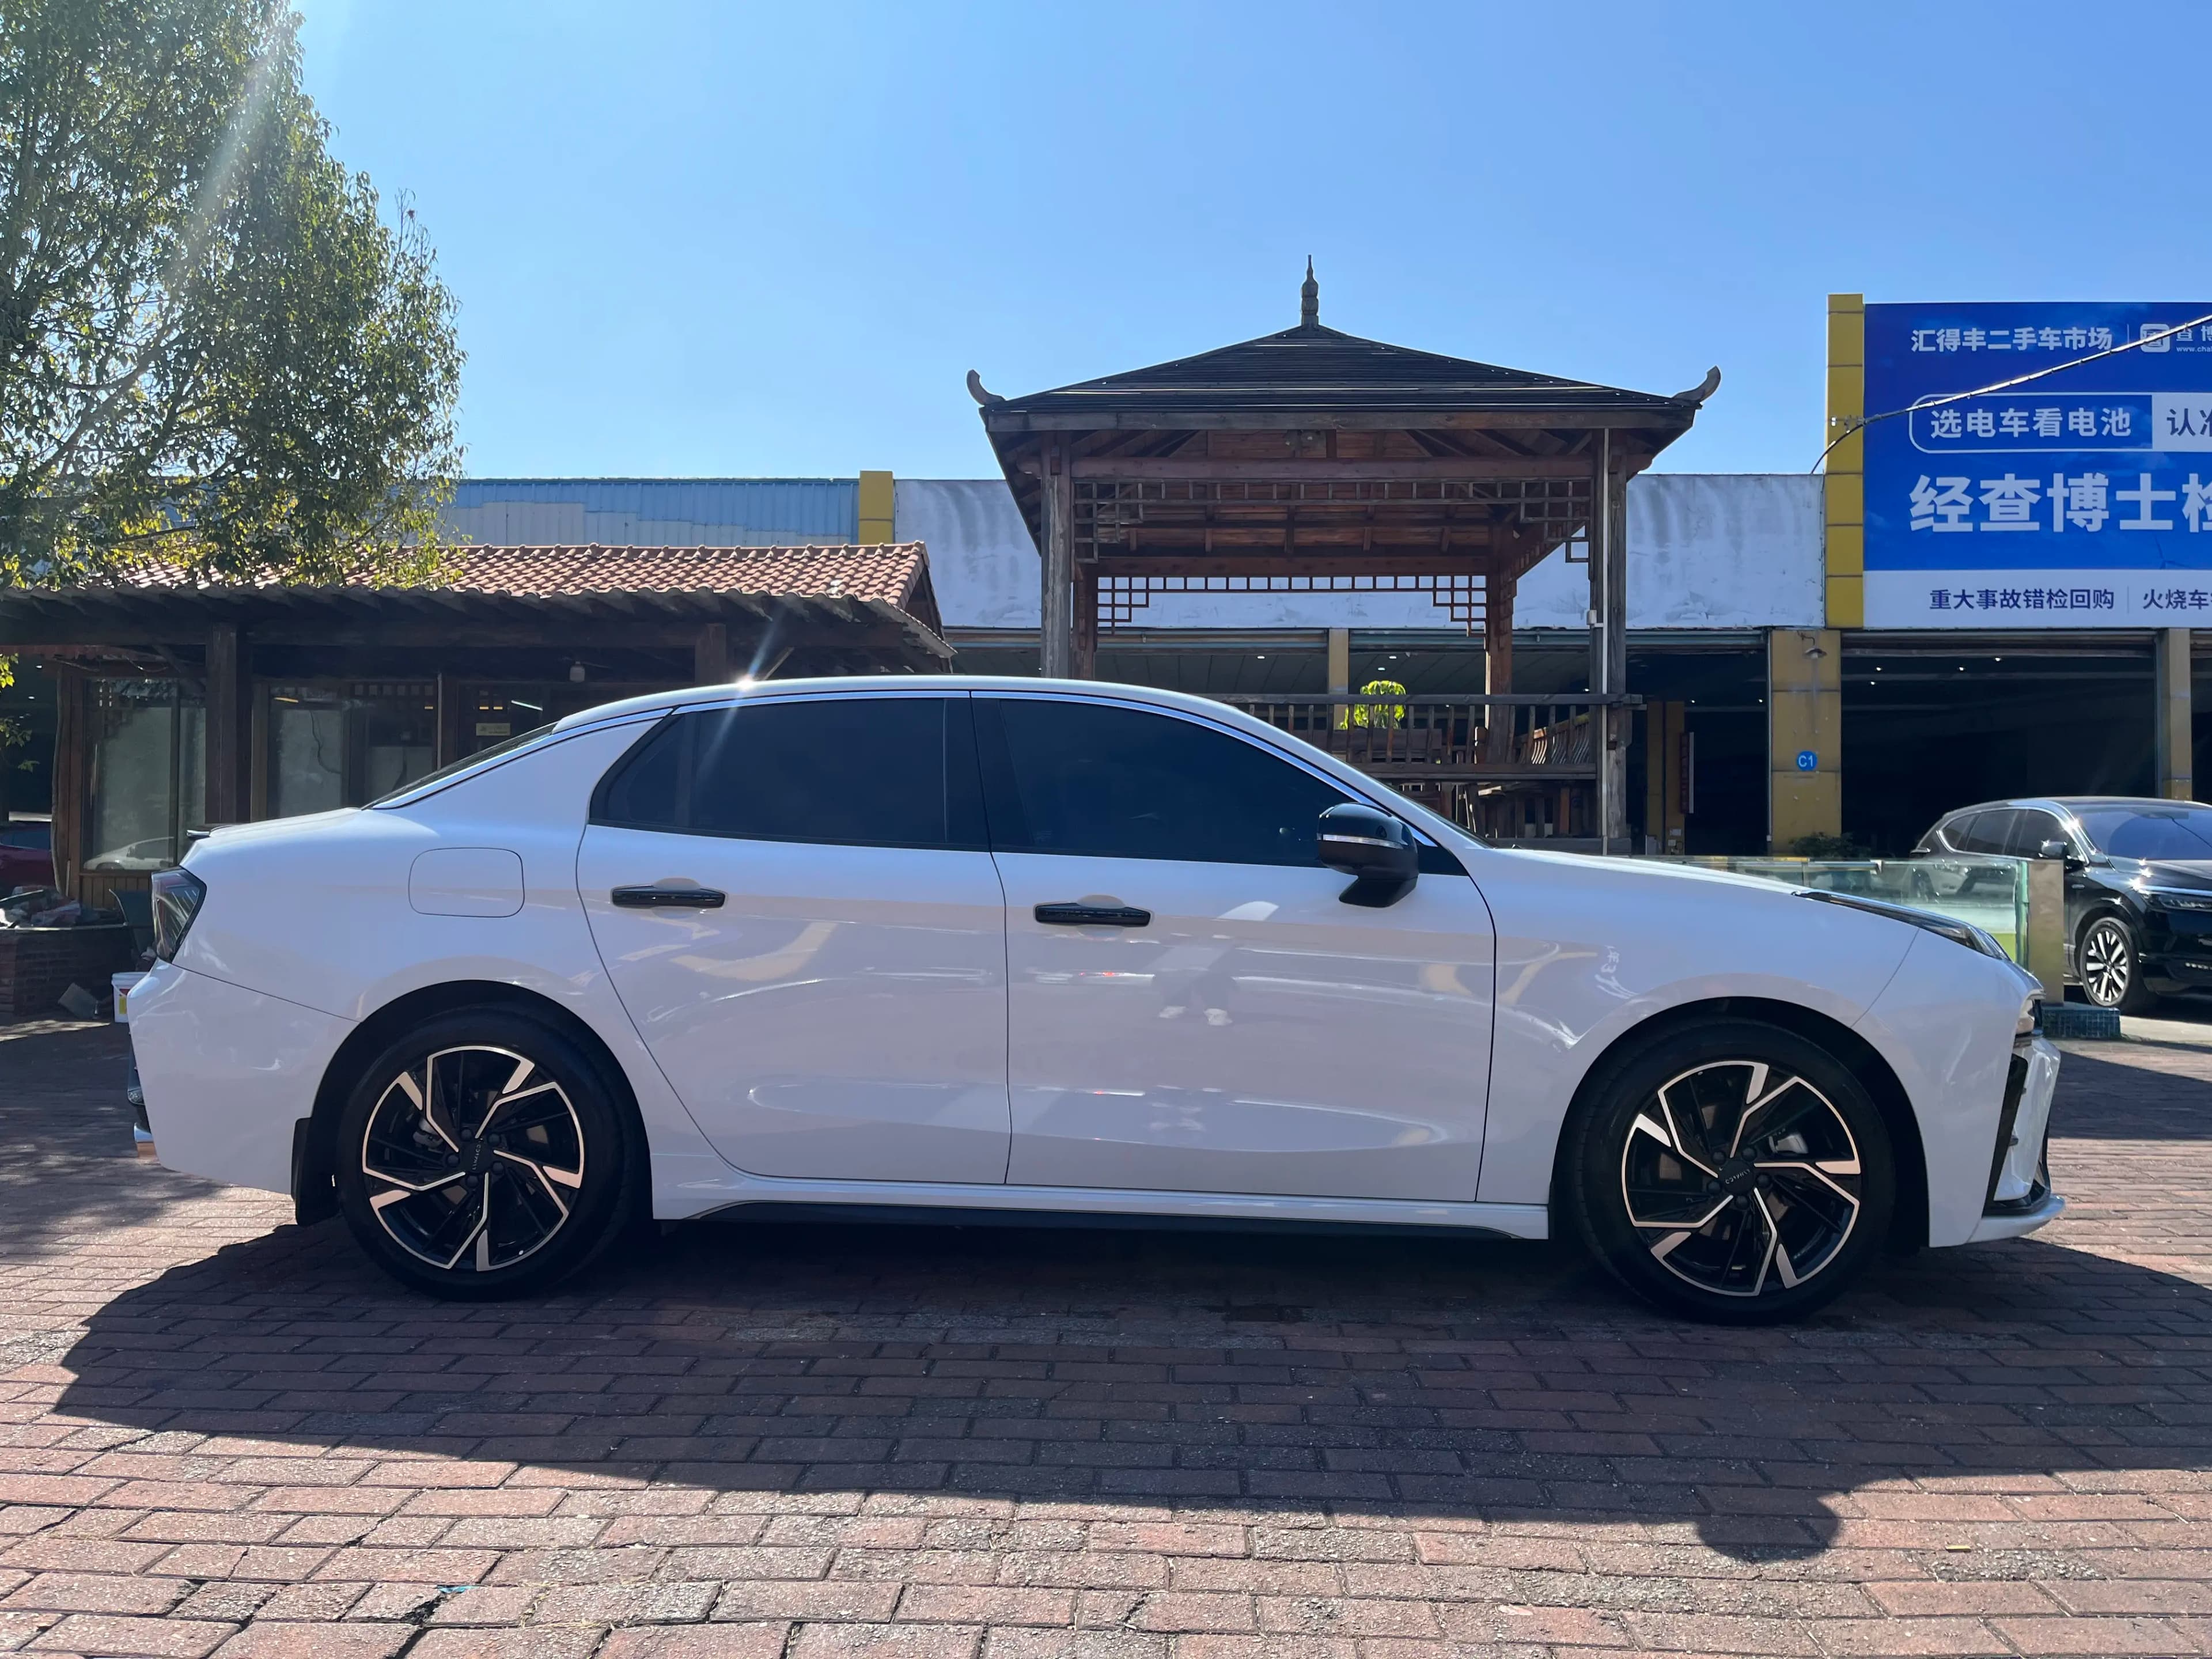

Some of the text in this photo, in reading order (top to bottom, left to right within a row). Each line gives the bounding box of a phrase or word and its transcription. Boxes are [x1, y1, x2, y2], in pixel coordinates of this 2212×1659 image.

[1911, 327, 2112, 351] 汇得丰二手车市场
[1930, 408, 2131, 438] 选电车看电池
[1930, 588, 2114, 610] 重大事故错检回购
[2143, 589, 2212, 610] 火烧车
[1798, 755, 1813, 767] C1
